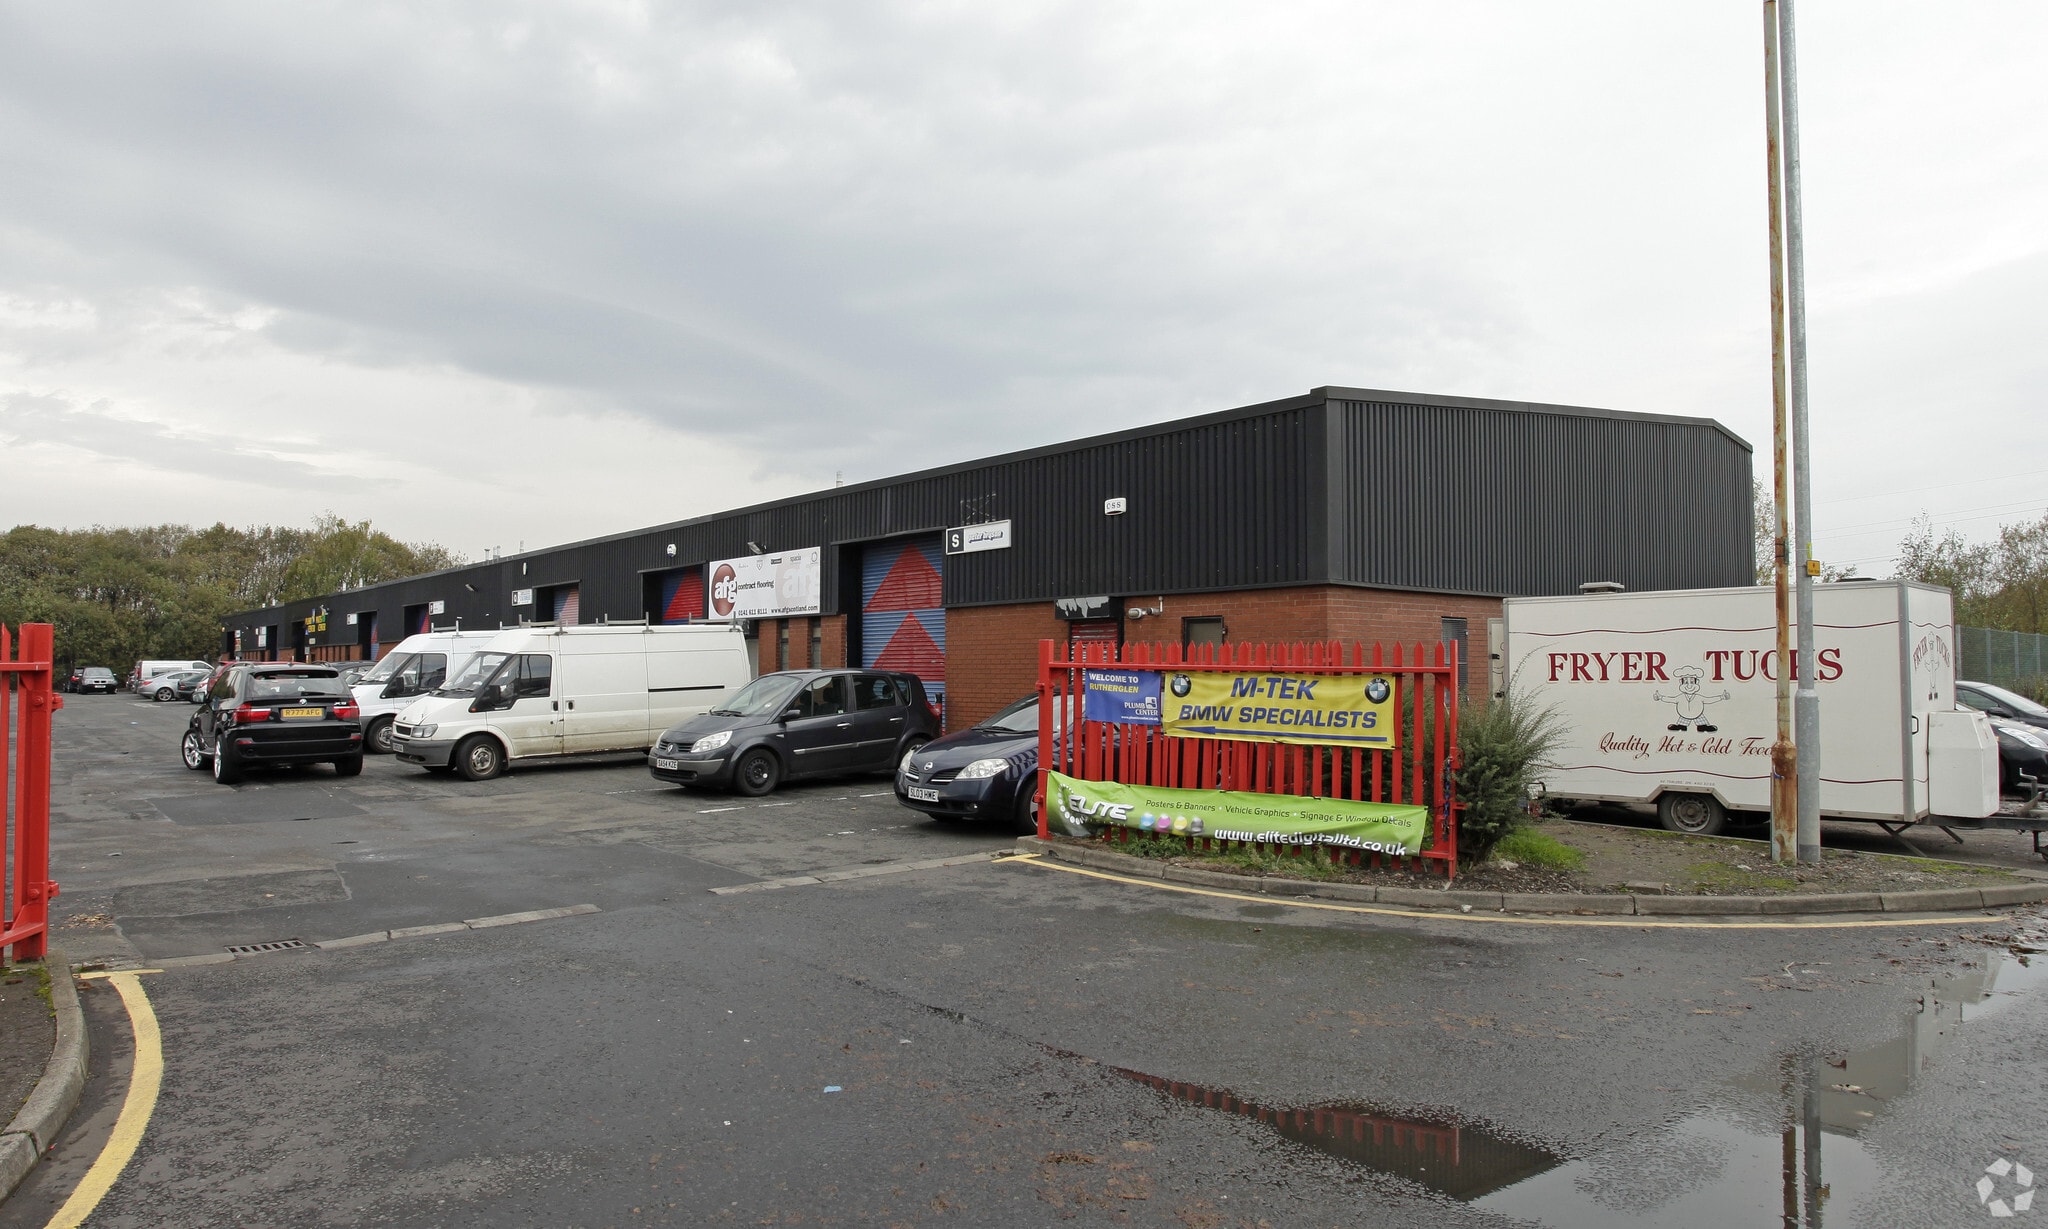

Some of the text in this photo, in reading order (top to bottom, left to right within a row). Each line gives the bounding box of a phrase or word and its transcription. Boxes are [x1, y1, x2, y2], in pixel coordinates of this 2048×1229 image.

[951, 533, 960, 548] S
[714, 575, 736, 603] afg
[737, 579, 775, 590] contract flooring
[1547, 651, 1670, 682] FRYER
[1088, 673, 1139, 684] WELCOME TO
[1089, 682, 1139, 693] RUTHERGLEN
[1230, 677, 1319, 700] M-TEK
[285, 709, 321, 717] R777 AFG
[1179, 704, 1377, 729] BMW SPECIALISTS
[1599, 732, 1650, 760] Quality
[1658, 735, 1685, 753] Hot
[1687, 743, 1698, 752] &
[1701, 736, 1733, 755] Cold
[910, 787, 923, 799] SL03
[1068, 794, 1135, 821] ELITE
[1145, 799, 1174, 809] Posters
[1184, 802, 1216, 811] Banners
[1225, 805, 1253, 814] Vehicle
[1254, 807, 1290, 818] Graphics
[1300, 811, 1335, 822] Signage
[1335, 814, 1343, 822] &
[1345, 815, 1380, 823] Window
[1381, 815, 1412, 828] Decals
